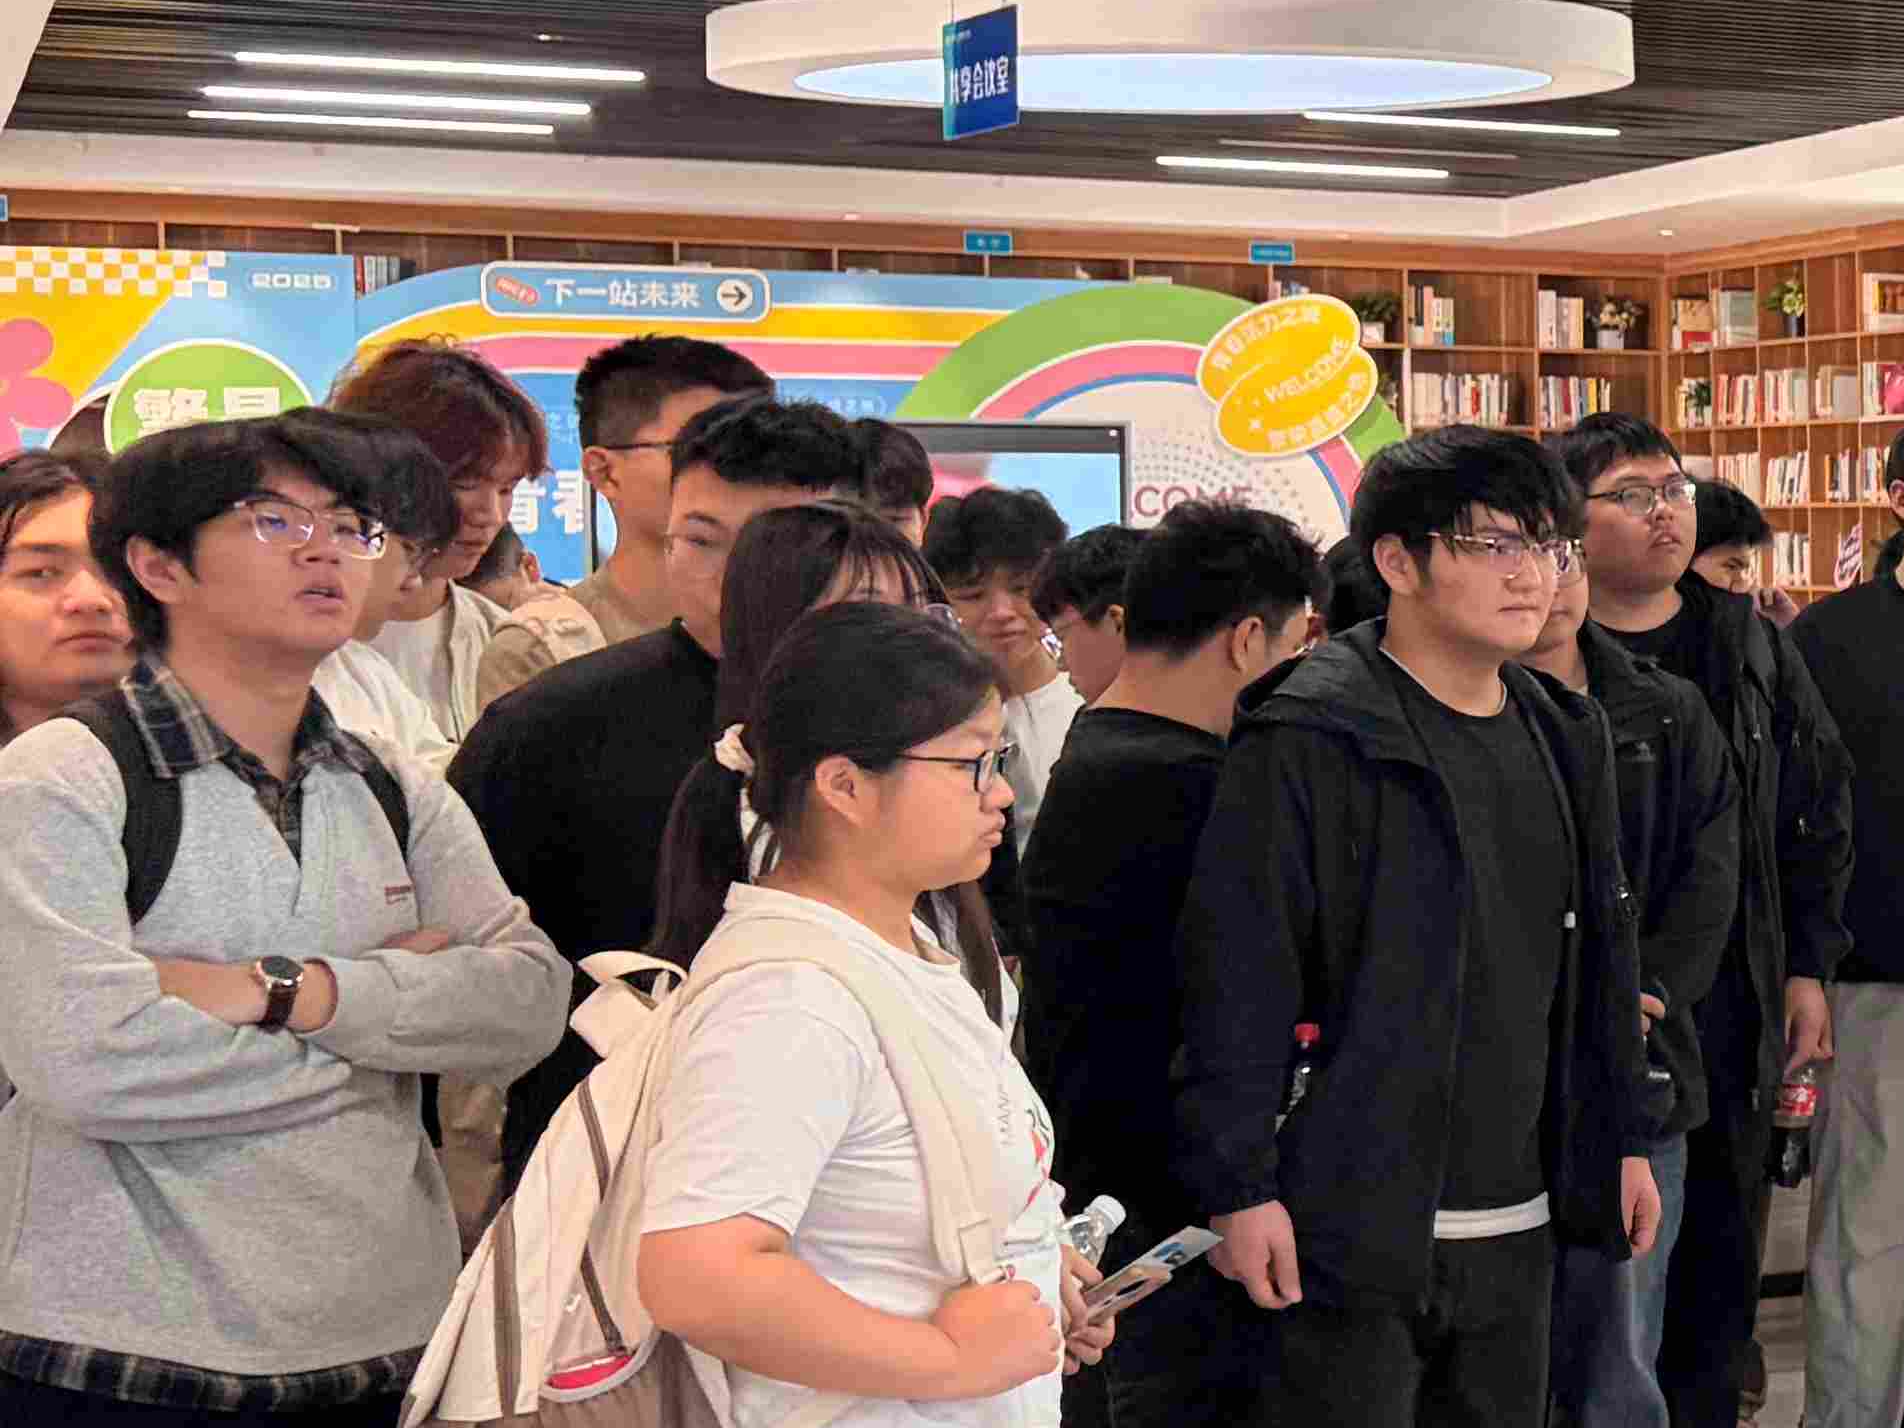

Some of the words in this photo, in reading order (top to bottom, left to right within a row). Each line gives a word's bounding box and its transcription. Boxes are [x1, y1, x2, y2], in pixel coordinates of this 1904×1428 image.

[544, 277, 700, 310] 下一站未来
